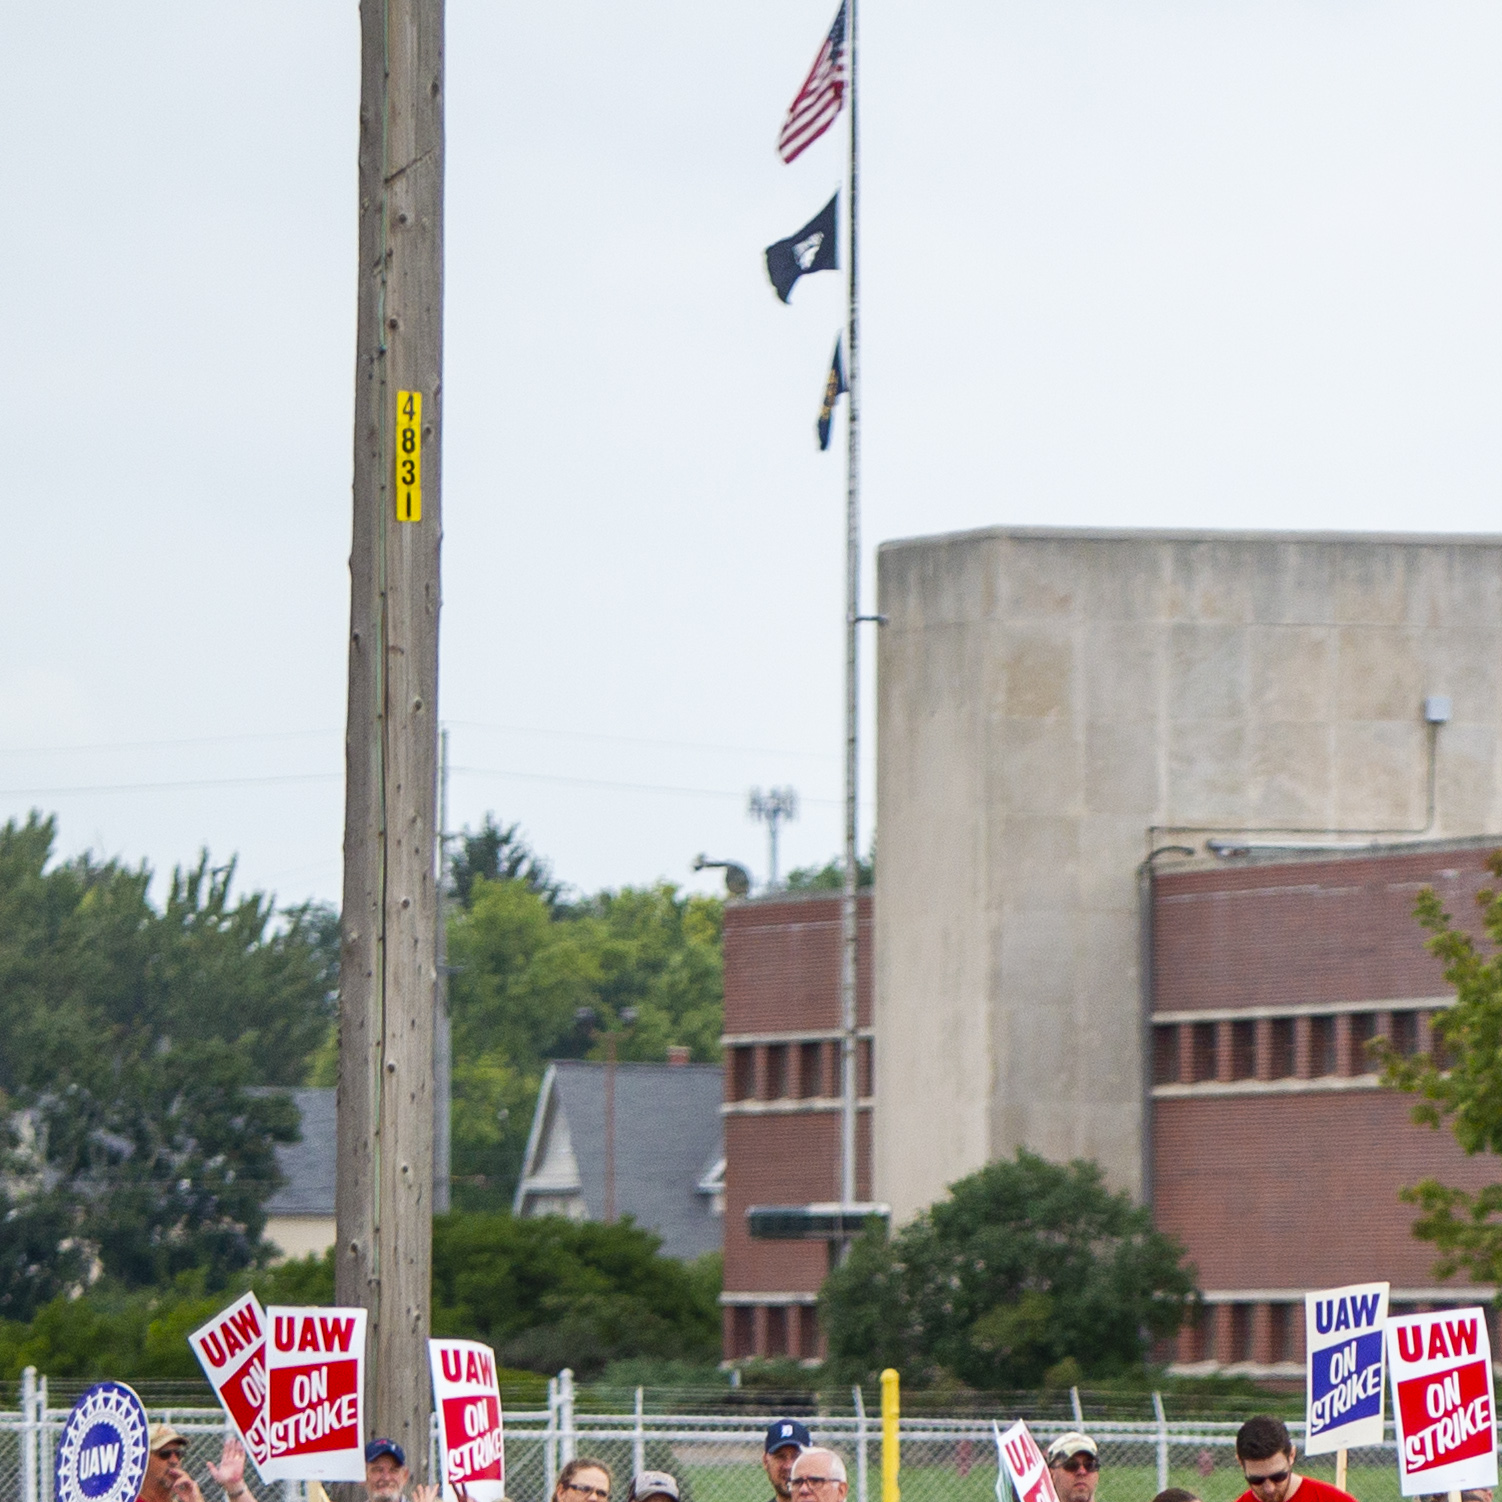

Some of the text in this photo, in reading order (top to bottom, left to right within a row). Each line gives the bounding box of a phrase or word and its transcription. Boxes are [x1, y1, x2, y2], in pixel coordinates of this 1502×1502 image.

[401, 392, 416, 519] 4831
[199, 1302, 262, 1368] UAW
[274, 1315, 356, 1353] UAW
[1315, 1292, 1381, 1335] UAW
[1329, 1340, 1358, 1385] ON
[1396, 1317, 1478, 1363] UAW
[292, 1365, 329, 1409] ON
[440, 1348, 494, 1389] UAW
[463, 1397, 490, 1438] ON
[1310, 1362, 1382, 1434] STRIKE
[1425, 1370, 1462, 1419] ON
[270, 1392, 358, 1455] STRIKE
[1405, 1394, 1492, 1471] STRIKE
[79, 1441, 121, 1481] UAW
[447, 1427, 503, 1482] STRIKE
